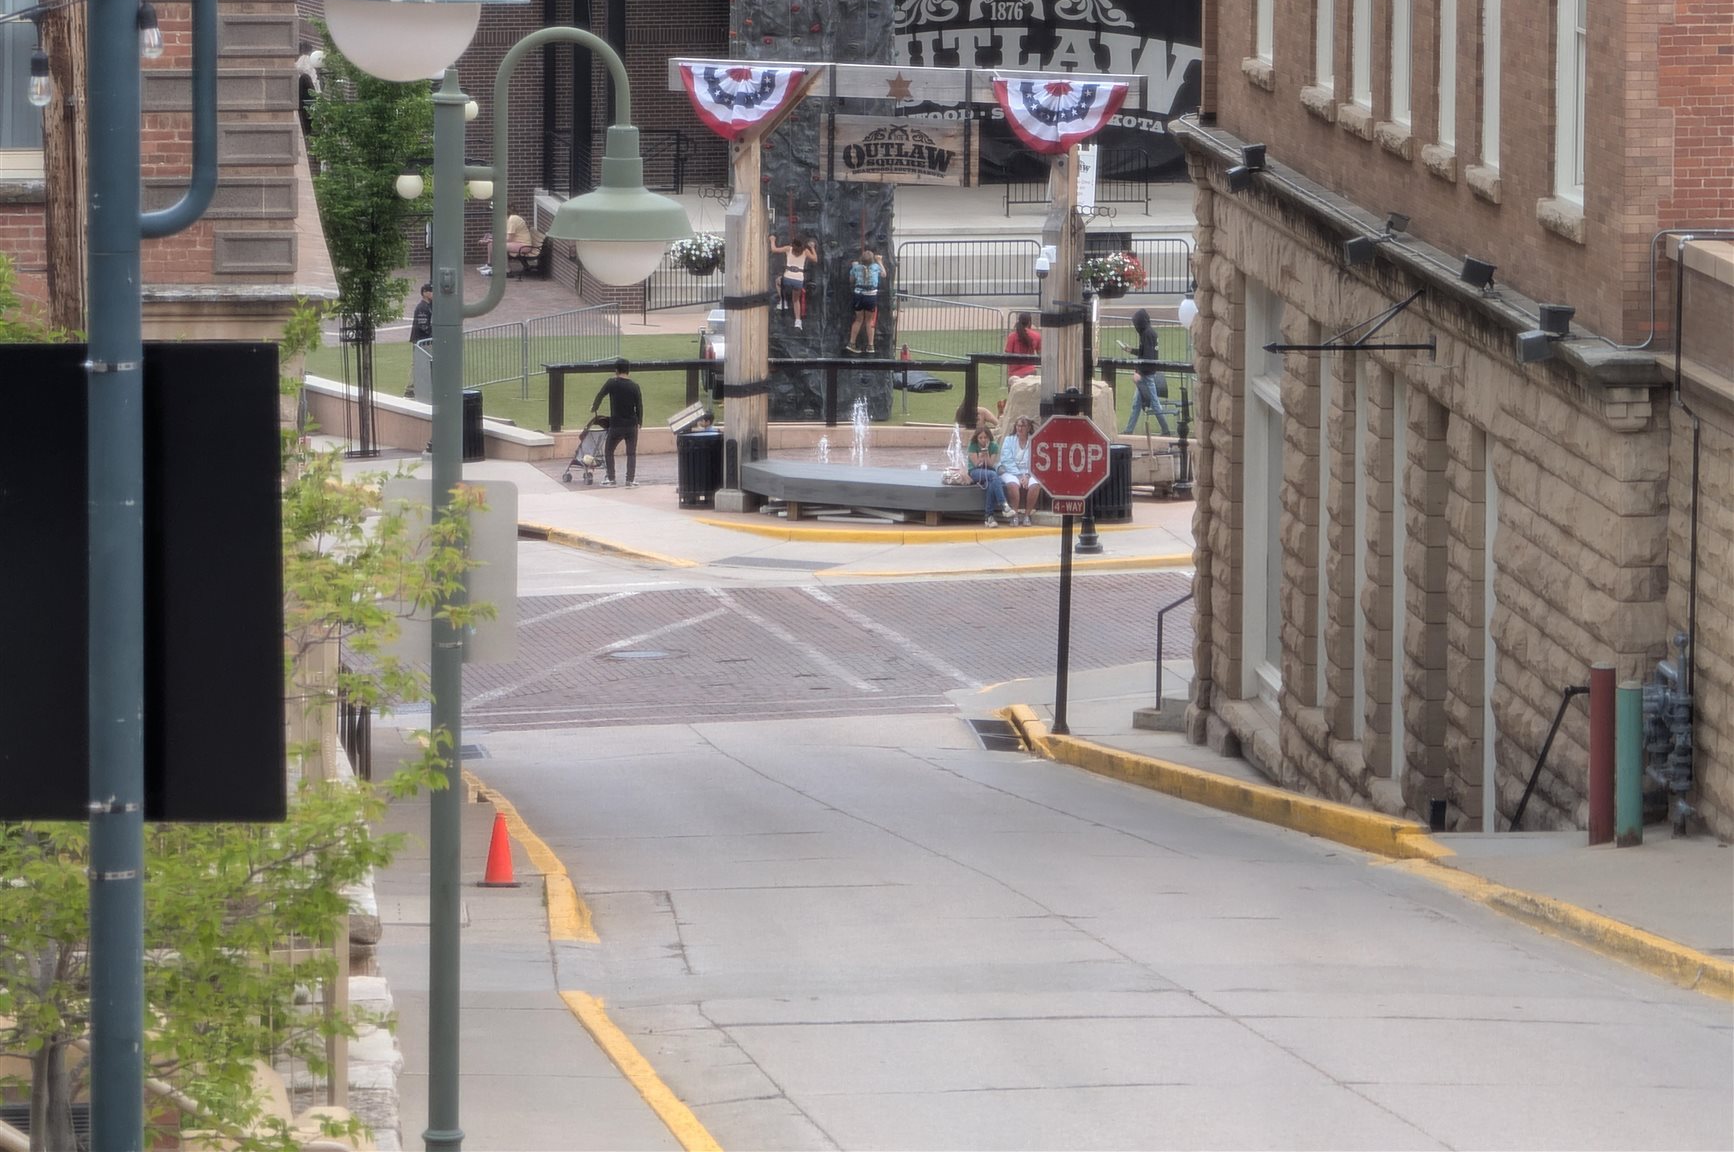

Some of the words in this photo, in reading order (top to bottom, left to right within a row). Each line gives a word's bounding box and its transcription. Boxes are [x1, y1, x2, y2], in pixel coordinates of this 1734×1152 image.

[990, 1, 1023, 21] 1876
[895, 27, 1202, 115] UTLAW
[843, 142, 956, 173] OUTLAW
[865, 158, 926, 169] SQUARE
[1035, 442, 1103, 473] STOP
[1054, 501, 1083, 512] 4-WAY
